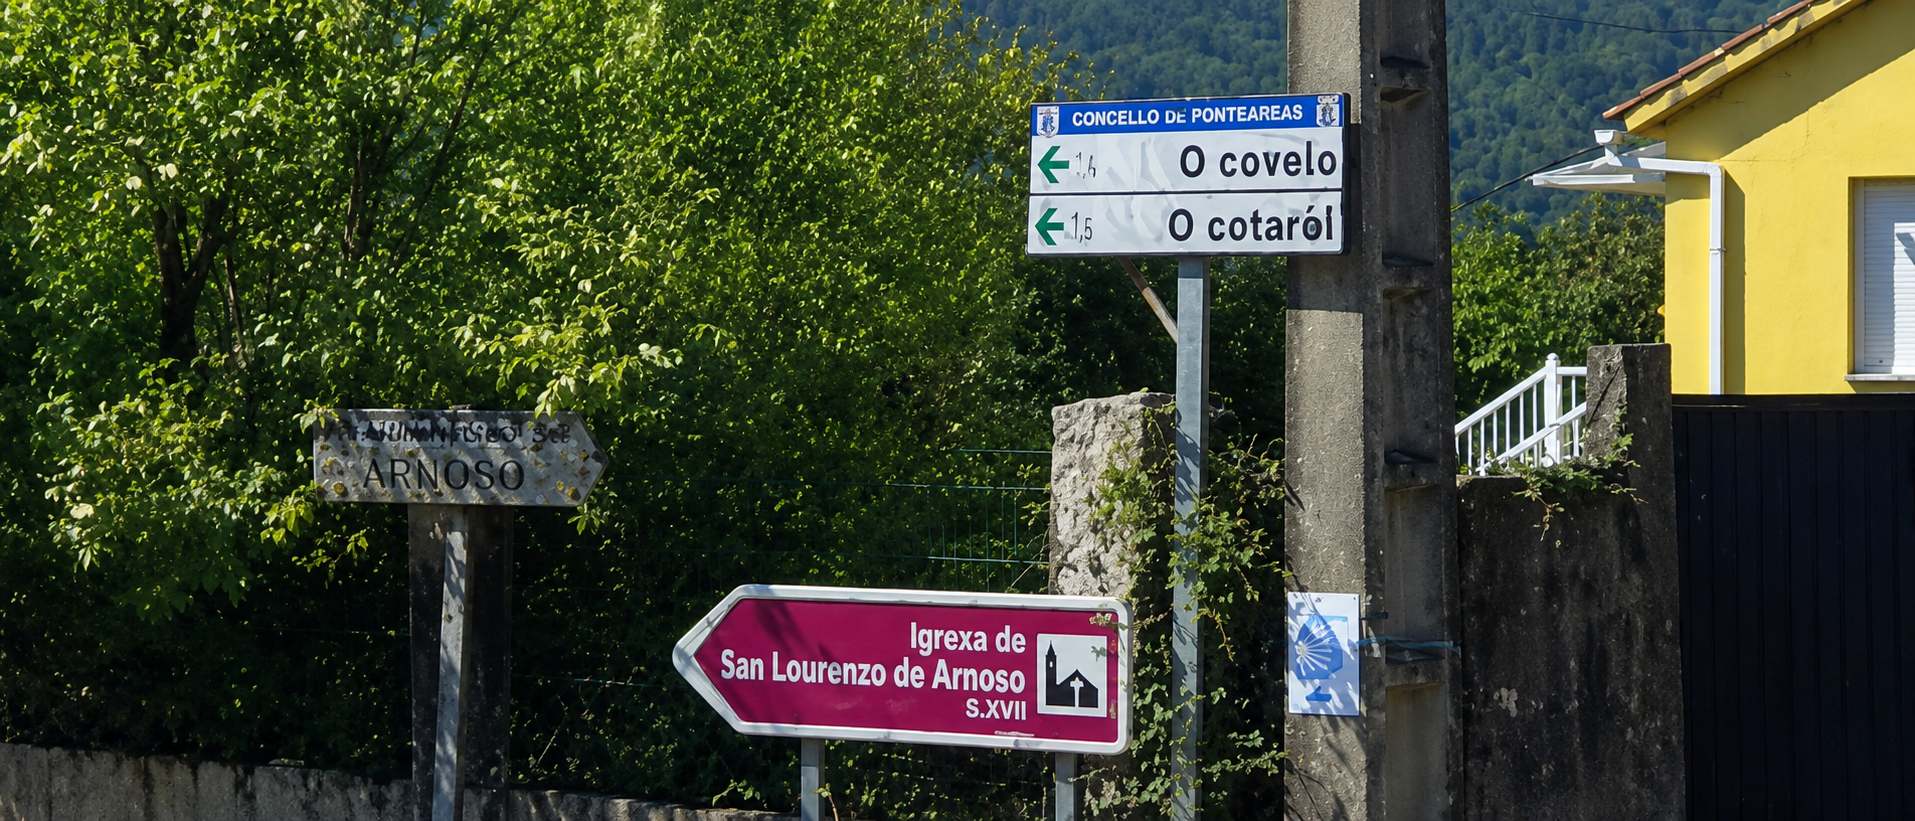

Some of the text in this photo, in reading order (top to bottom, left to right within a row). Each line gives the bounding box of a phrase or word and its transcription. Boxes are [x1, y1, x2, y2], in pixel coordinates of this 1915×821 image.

[1072, 104, 1303, 127] CONCELLO DE PONTEAREAS
[1180, 140, 1337, 178] O covelo
[1168, 208, 1194, 242] O
[362, 458, 526, 491] ARNOSO
[910, 621, 1027, 657] Igrexa de
[721, 648, 1026, 694] San Lourenzo de Arnoso
[965, 697, 1027, 721] S.XVII
